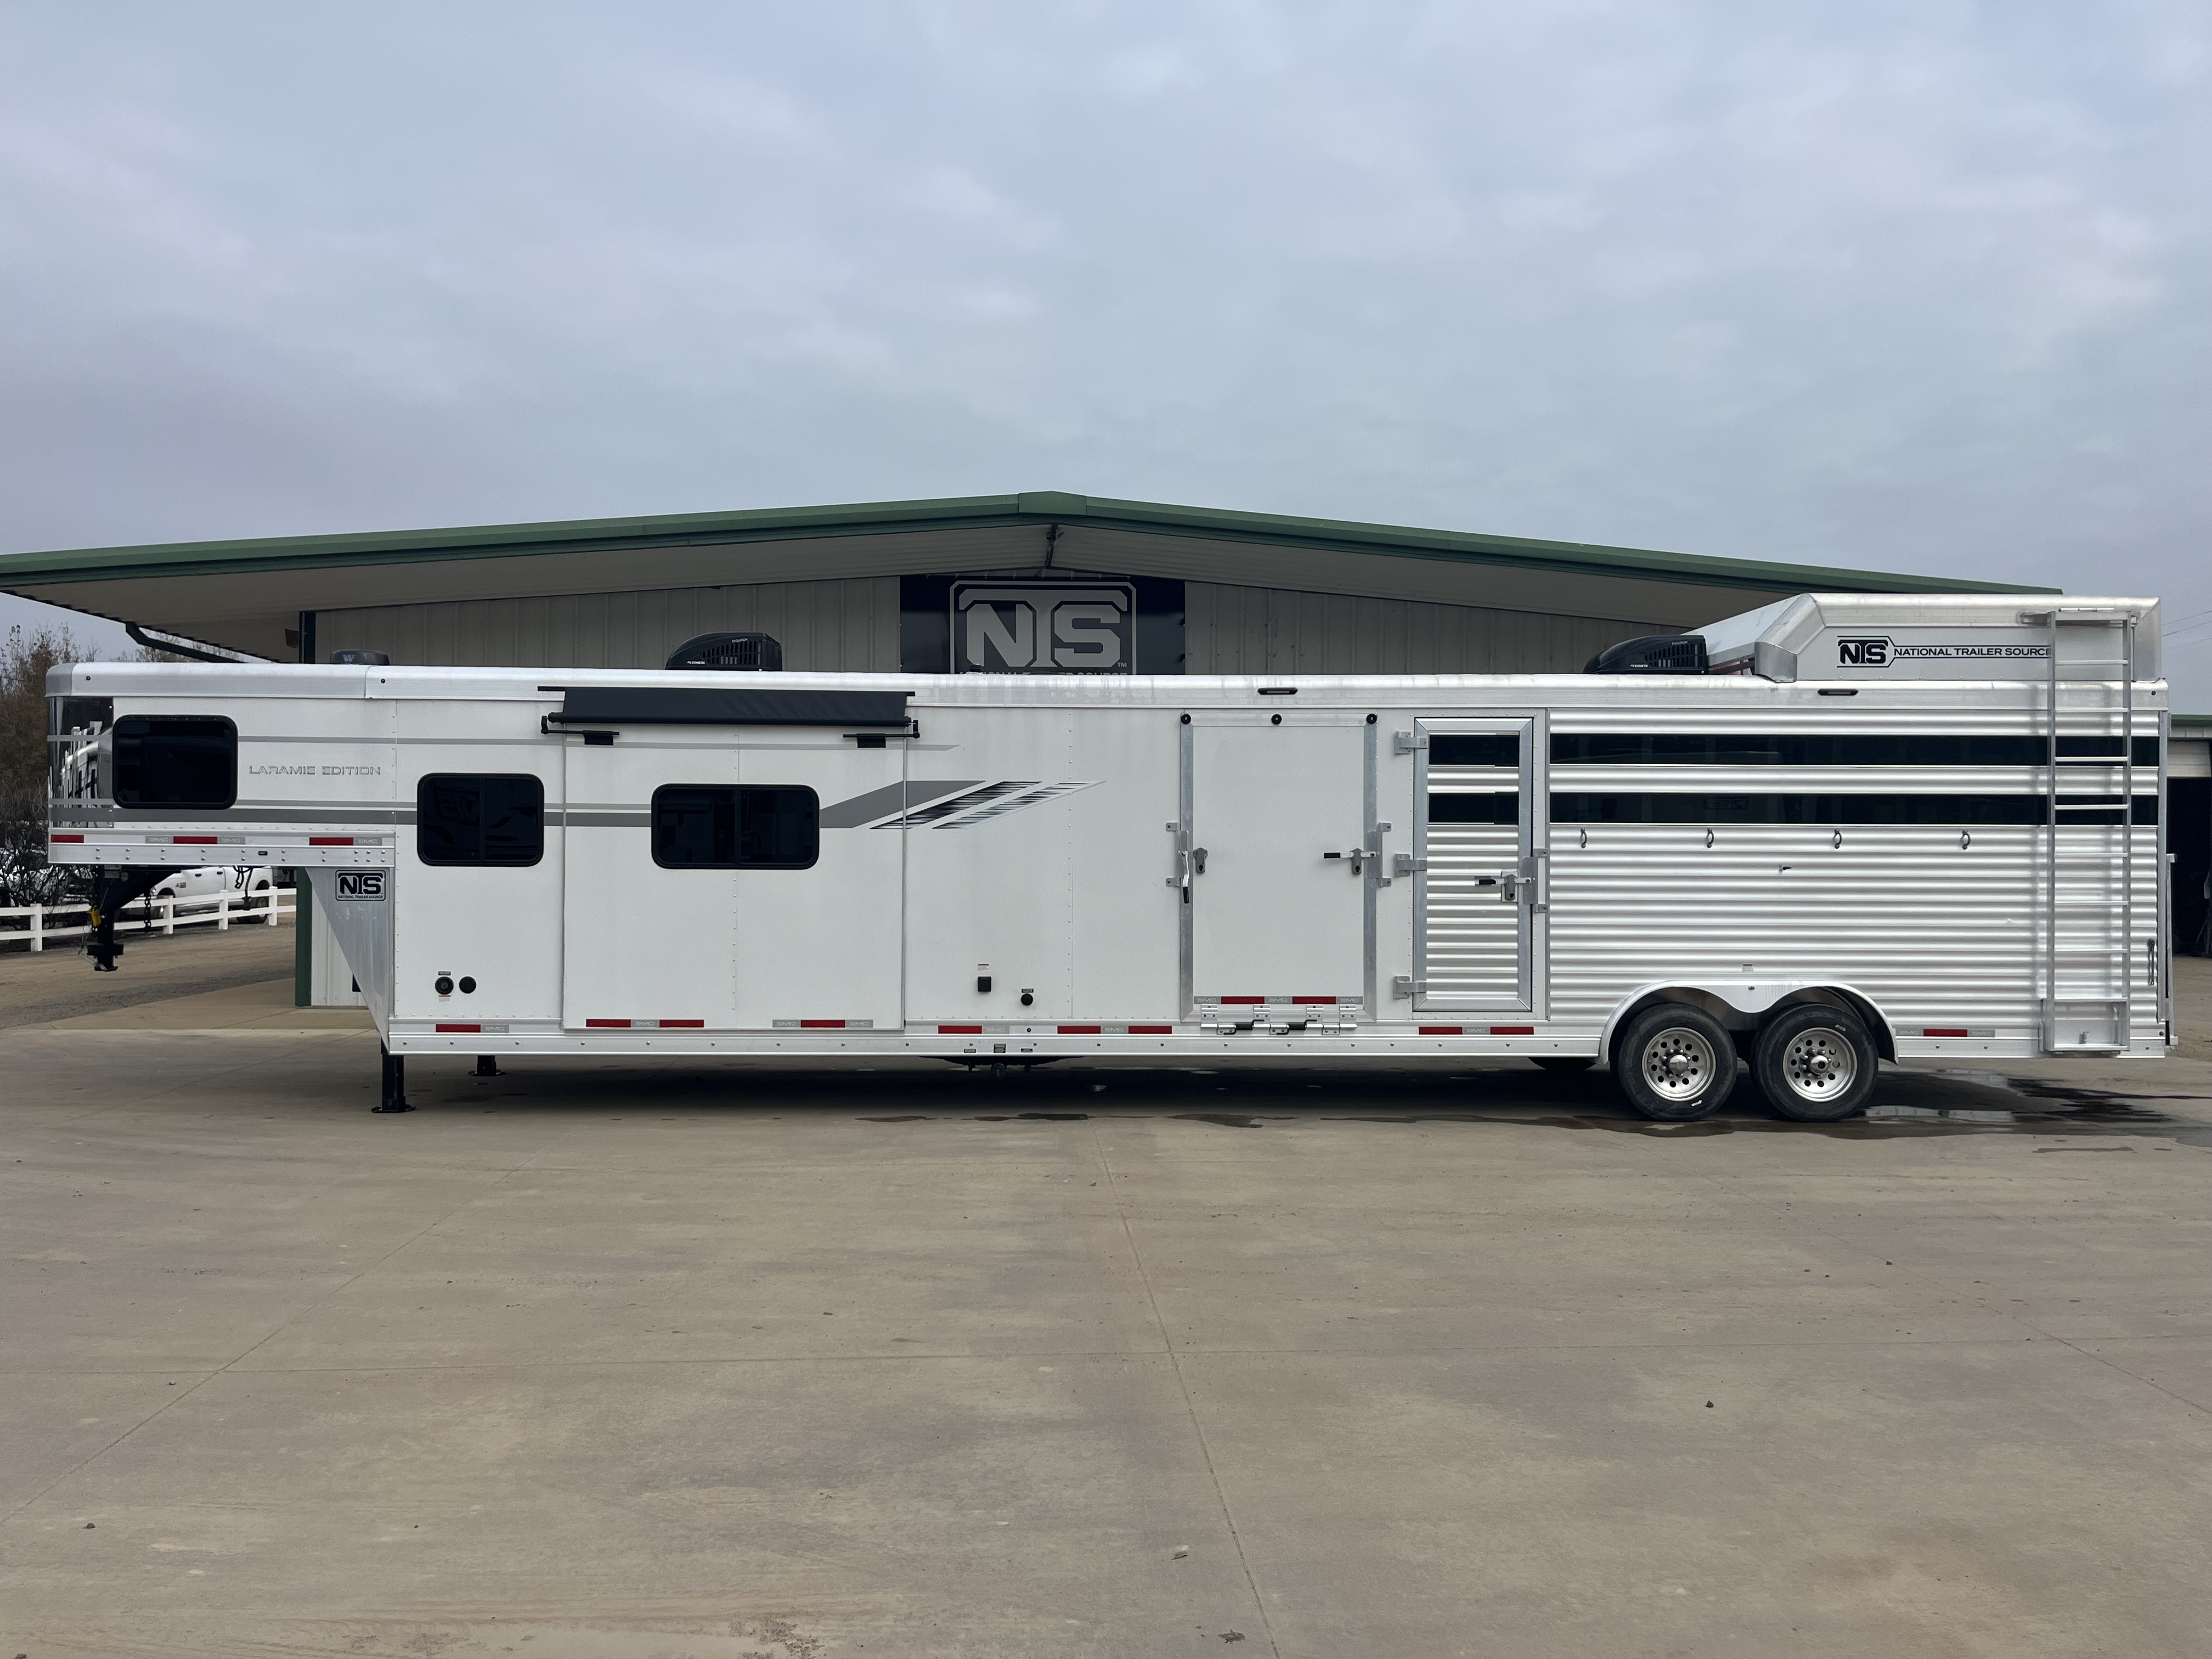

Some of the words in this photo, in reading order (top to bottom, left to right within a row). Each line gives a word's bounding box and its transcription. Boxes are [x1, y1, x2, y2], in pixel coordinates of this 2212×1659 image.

[959, 589, 1127, 668] NTS
[1838, 639, 1888, 664] NTS
[1894, 648, 1952, 656] NATIONAL
[1954, 648, 2002, 656] TRAILER
[249, 765, 315, 775] LARAMIE
[321, 766, 381, 776] EDITION
[338, 873, 383, 894] NTS
